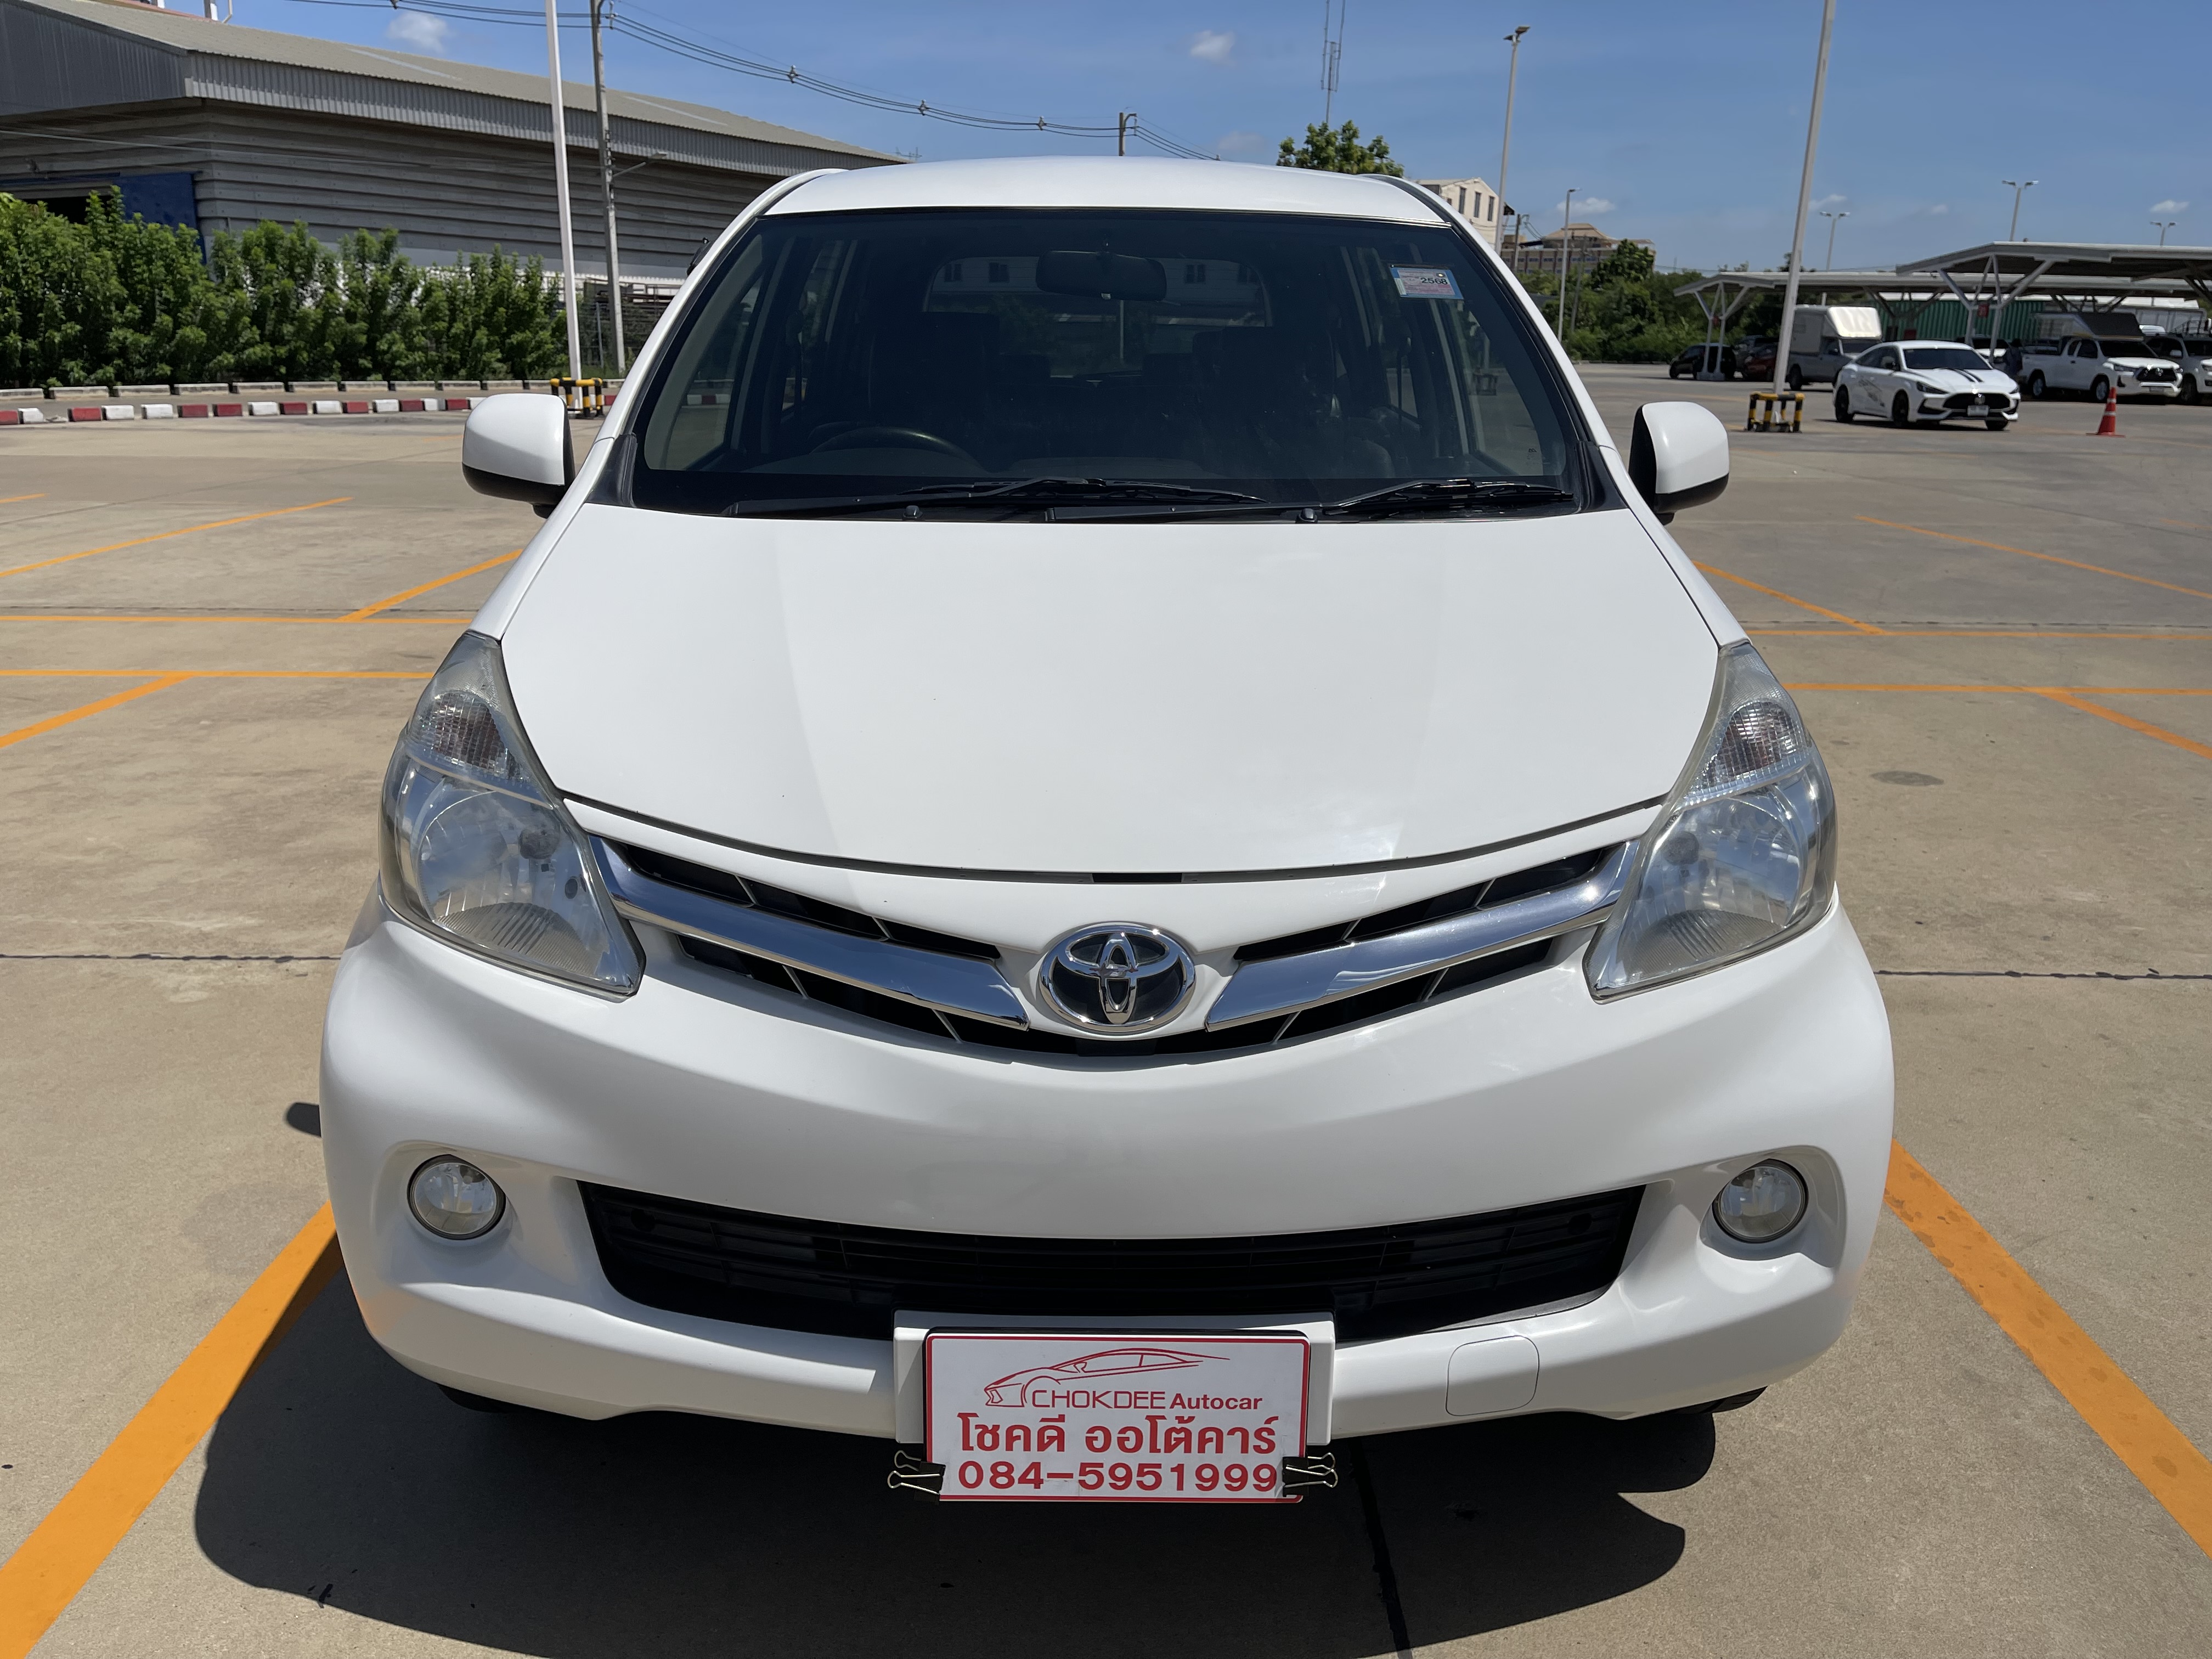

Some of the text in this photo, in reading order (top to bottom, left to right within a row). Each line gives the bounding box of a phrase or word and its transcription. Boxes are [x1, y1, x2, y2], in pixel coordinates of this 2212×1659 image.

[1032, 1390, 1263, 1410] CHOKDEE Autocar
[957, 1412, 1279, 1454] โชคดี ออโต้คาร์
[958, 1460, 1278, 1492] 084-5951999
